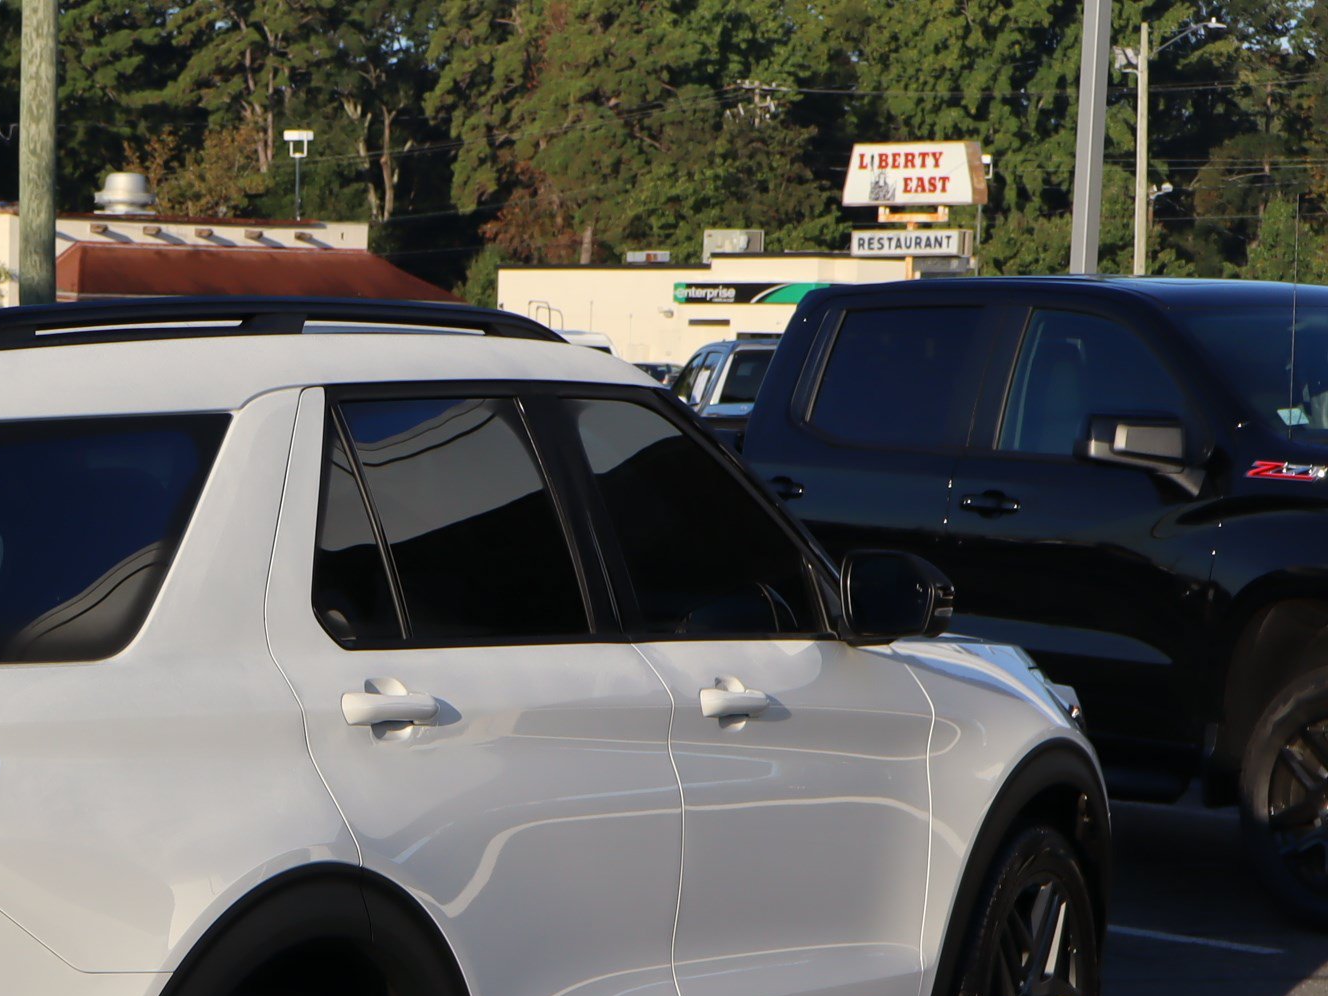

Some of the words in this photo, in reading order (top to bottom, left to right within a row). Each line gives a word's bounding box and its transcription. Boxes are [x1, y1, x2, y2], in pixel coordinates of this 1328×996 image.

[903, 176, 950, 193] EAST
[857, 235, 953, 250] RESTAURANT
[675, 285, 736, 300] enterprise
